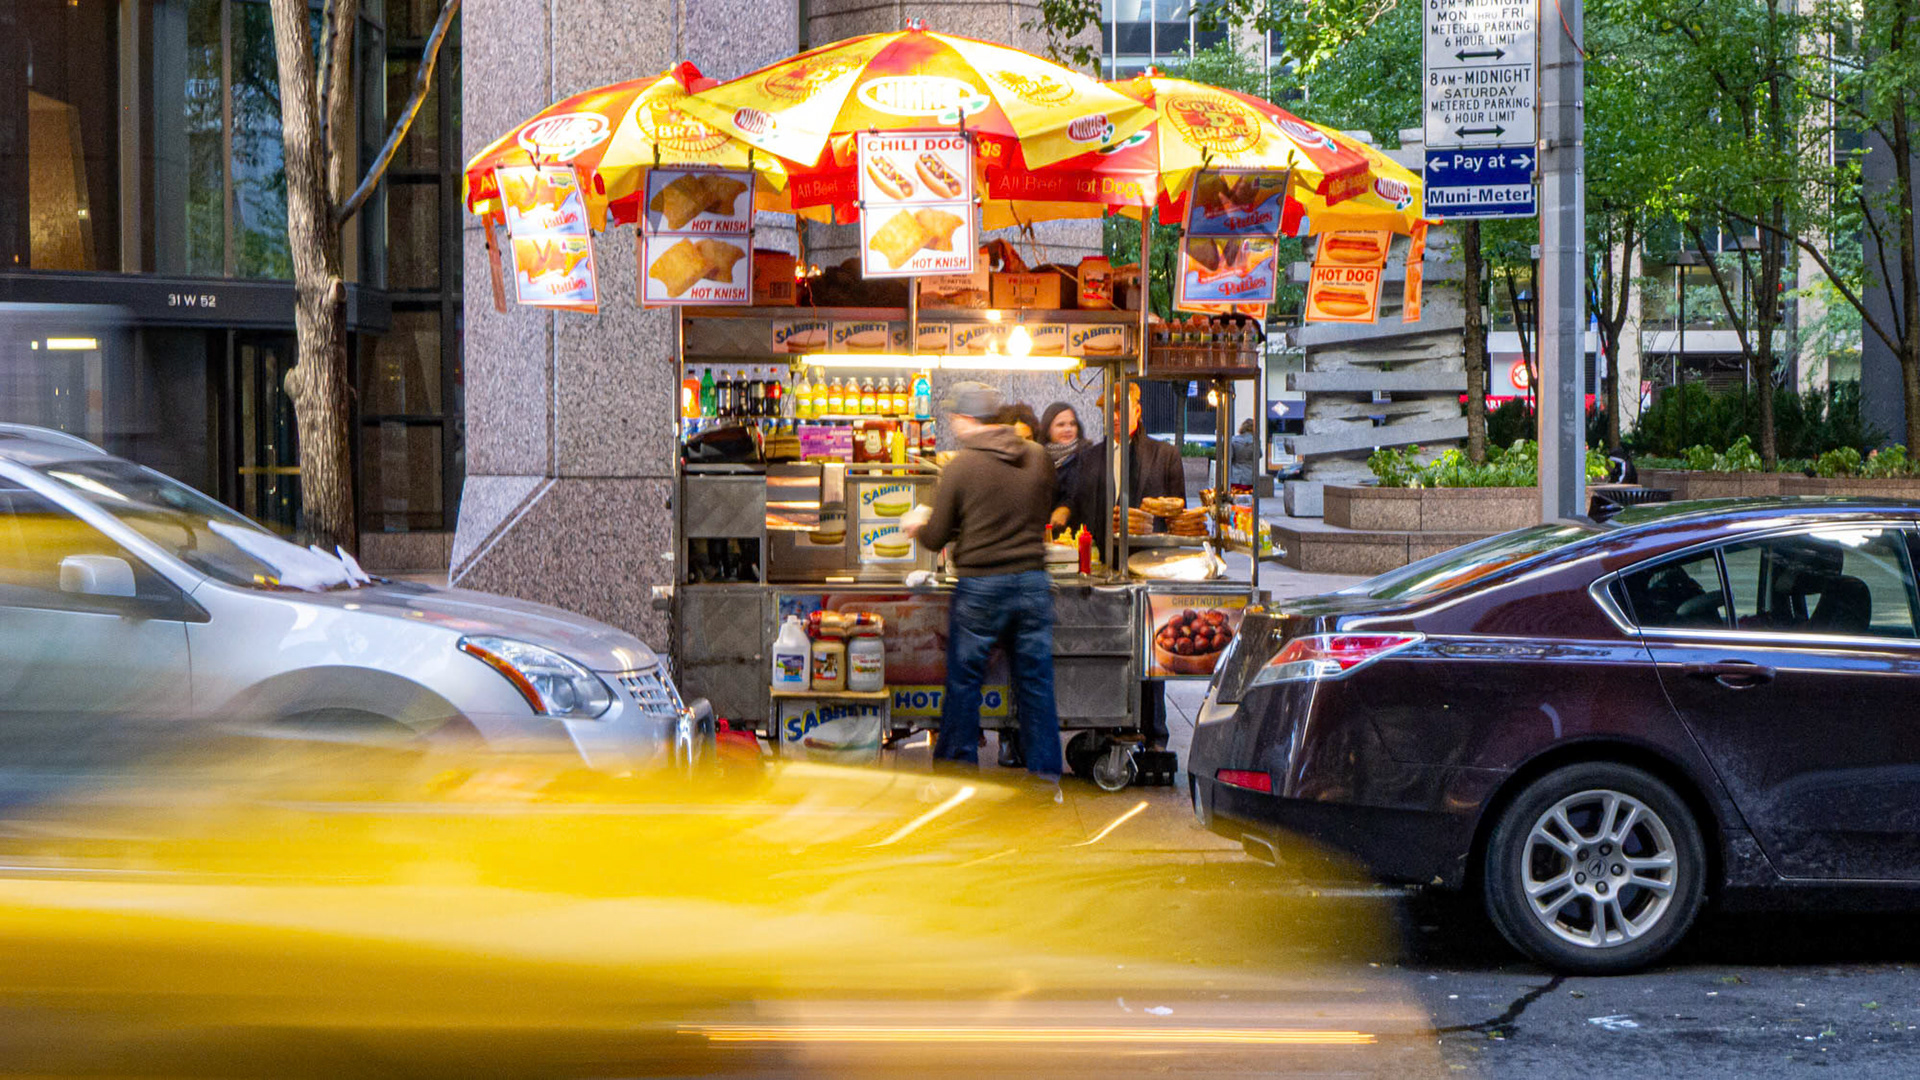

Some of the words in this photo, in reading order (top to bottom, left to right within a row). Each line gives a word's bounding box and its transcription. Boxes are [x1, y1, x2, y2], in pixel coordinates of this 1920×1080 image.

[1438, 11, 1467, 21] MON
[1473, 12, 1497, 20] THRU
[1502, 8, 1524, 18] FRI
[1431, 23, 1479, 35] METERED
[1485, 20, 1530, 32] PARKING
[1445, 37, 1451, 47] 6
[1455, 35, 1484, 46] HOUR
[1489, 34, 1515, 45] LIMIT
[1430, 72, 1437, 86] 8
[1441, 75, 1455, 85] AM
[1465, 68, 1531, 84] MIDNIGHT
[1444, 86, 1516, 99] SATURDAY
[1431, 99, 1479, 111] METERED
[1484, 97, 1530, 109] PARKING
[1445, 114, 1451, 123] 6
[1455, 111, 1484, 123] HOUR
[1489, 111, 1515, 122] LIMIT
[659, 125, 715, 138] BRAN
[867, 139, 917, 152] CHILI
[925, 138, 965, 151] DOG
[1454, 154, 1483, 172] Pay
[1488, 154, 1506, 168] at
[798, 183, 811, 198] All
[1000, 175, 1019, 190] All
[1102, 177, 1145, 199] Dogs
[1377, 177, 1405, 200] NIKAS
[1430, 188, 1530, 204] Muni-Meter
[692, 221, 712, 231] HOT
[715, 220, 747, 231] KNISH
[912, 257, 931, 269] HOT
[935, 256, 967, 268] KNISH
[1317, 269, 1343, 281] HOT
[1346, 269, 1375, 283] DOG
[691, 288, 711, 298] HOT
[714, 288, 746, 298] KNISH
[168, 294, 180, 306] 31
[184, 294, 197, 306] W
[200, 294, 216, 307] 52
[775, 322, 826, 344] SABRETT
[835, 322, 886, 344] SABRETT
[1072, 326, 1123, 347] SABRETT
[862, 484, 911, 505] SABRETT
[1172, 597, 1223, 607] CHESTNUTS
[894, 691, 942, 709] HOT
